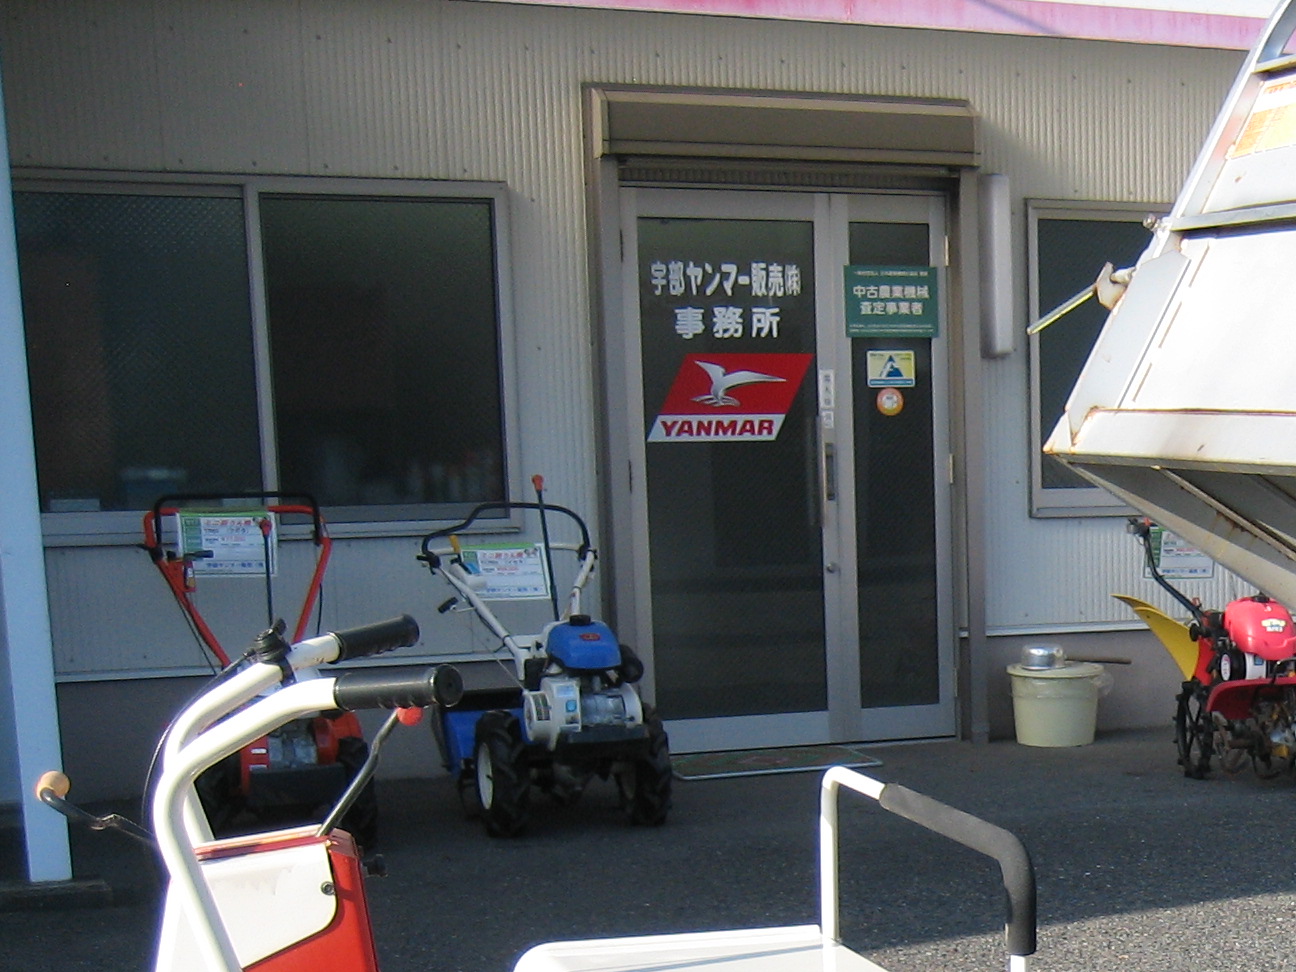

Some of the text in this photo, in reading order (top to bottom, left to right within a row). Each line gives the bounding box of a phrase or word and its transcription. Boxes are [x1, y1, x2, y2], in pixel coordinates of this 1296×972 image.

[674, 306, 781, 340] 事務所
[660, 419, 775, 437] YANMAR
